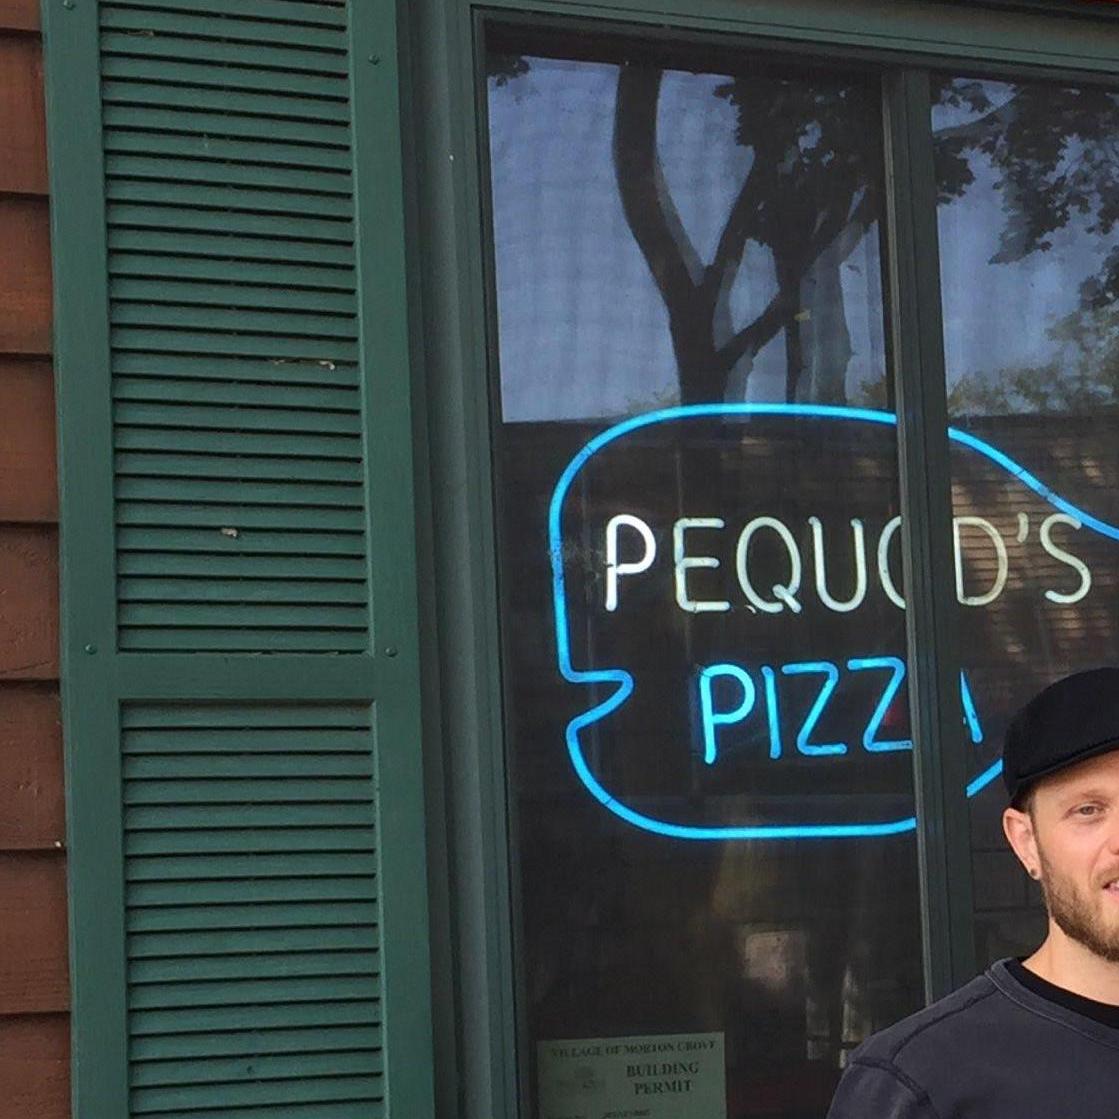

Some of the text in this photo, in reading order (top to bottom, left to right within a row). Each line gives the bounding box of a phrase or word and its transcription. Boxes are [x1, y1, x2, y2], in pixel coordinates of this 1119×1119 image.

[699, 656, 983, 765] PIZZ
[551, 1046, 602, 1058] VILLAGE
[605, 1045, 620, 1055] OF
[624, 1042, 673, 1055] MORTON
[626, 1061, 700, 1078] BUILDING
[634, 1080, 694, 1095] PERMIT
